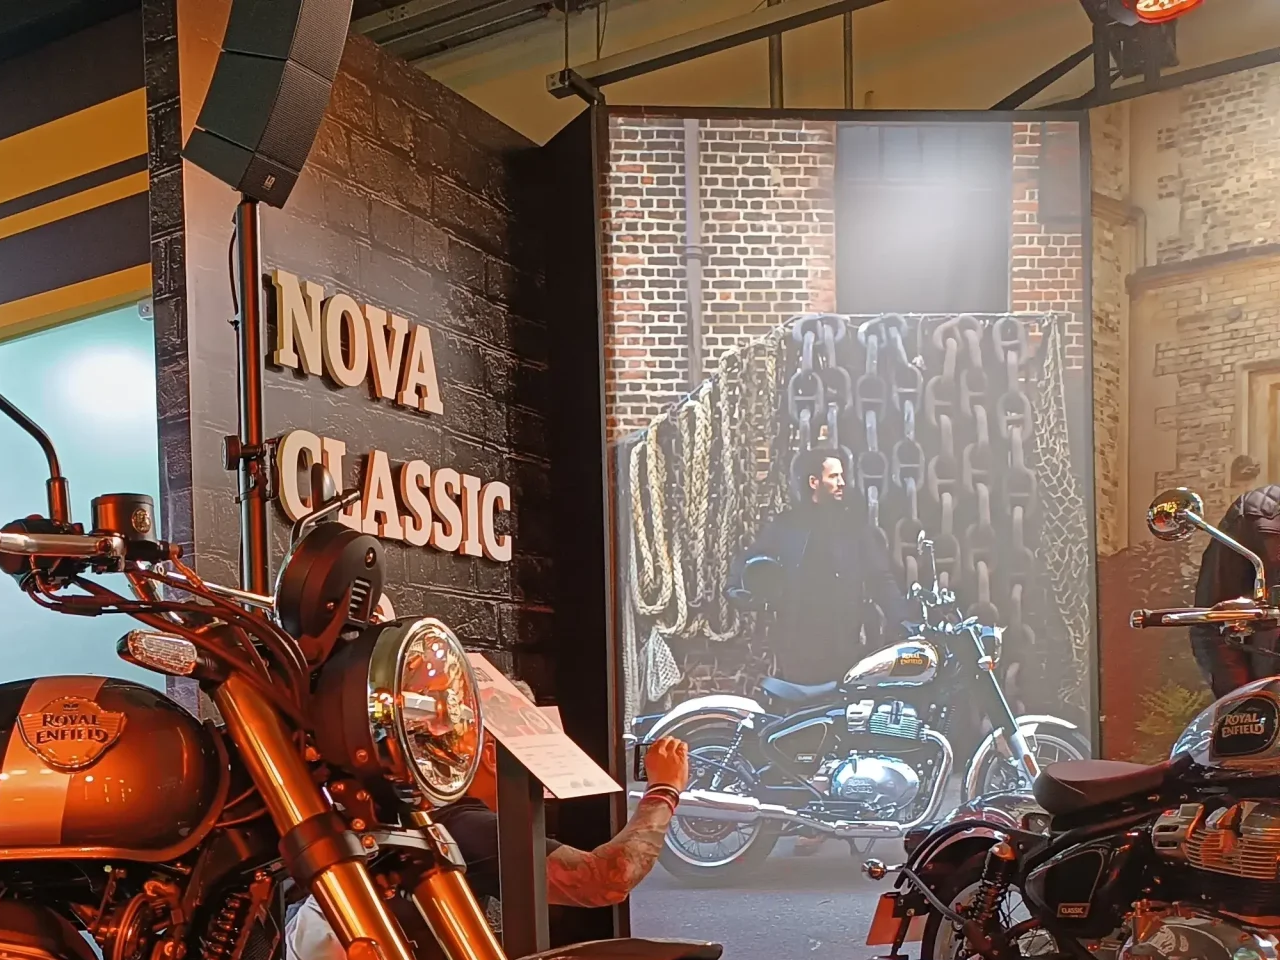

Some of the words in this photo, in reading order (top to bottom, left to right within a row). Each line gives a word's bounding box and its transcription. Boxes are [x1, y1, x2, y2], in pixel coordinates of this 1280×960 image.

[272, 268, 444, 416] NOVA
[276, 429, 512, 562] CLASSIC
[42, 713, 101, 729] ROYAL
[1225, 713, 1260, 726] ROYAL
[36, 729, 109, 745] ENFIELD
[1222, 724, 1265, 738] ENFIELD
